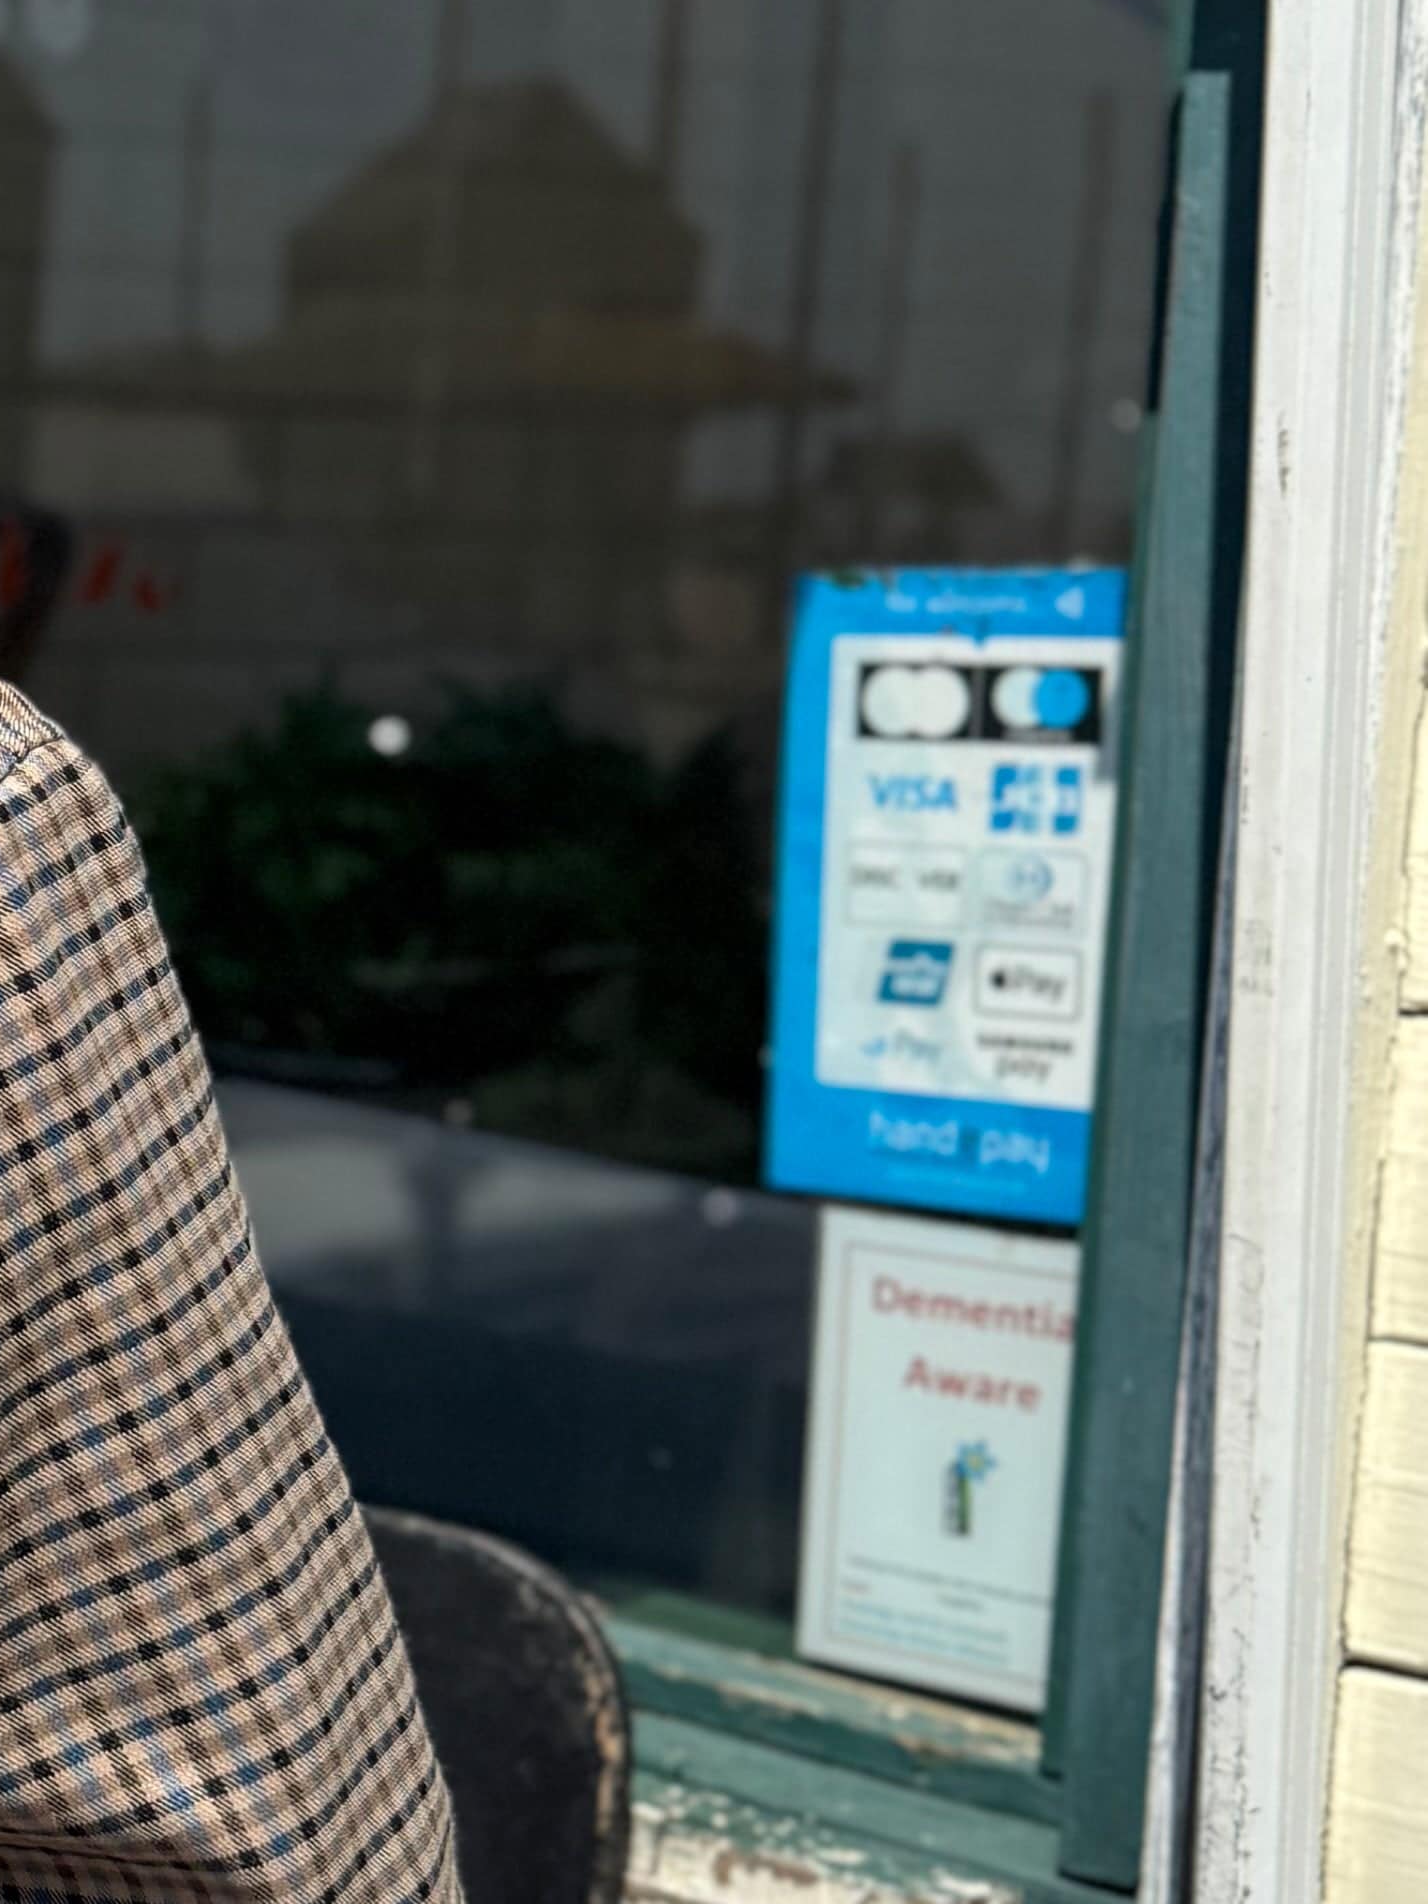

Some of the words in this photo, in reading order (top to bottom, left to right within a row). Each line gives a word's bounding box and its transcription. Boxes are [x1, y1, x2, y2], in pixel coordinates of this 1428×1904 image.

[867, 770, 958, 813] VISA
[871, 1274, 1074, 1345] Dementia
[902, 1354, 1042, 1414] Aware
